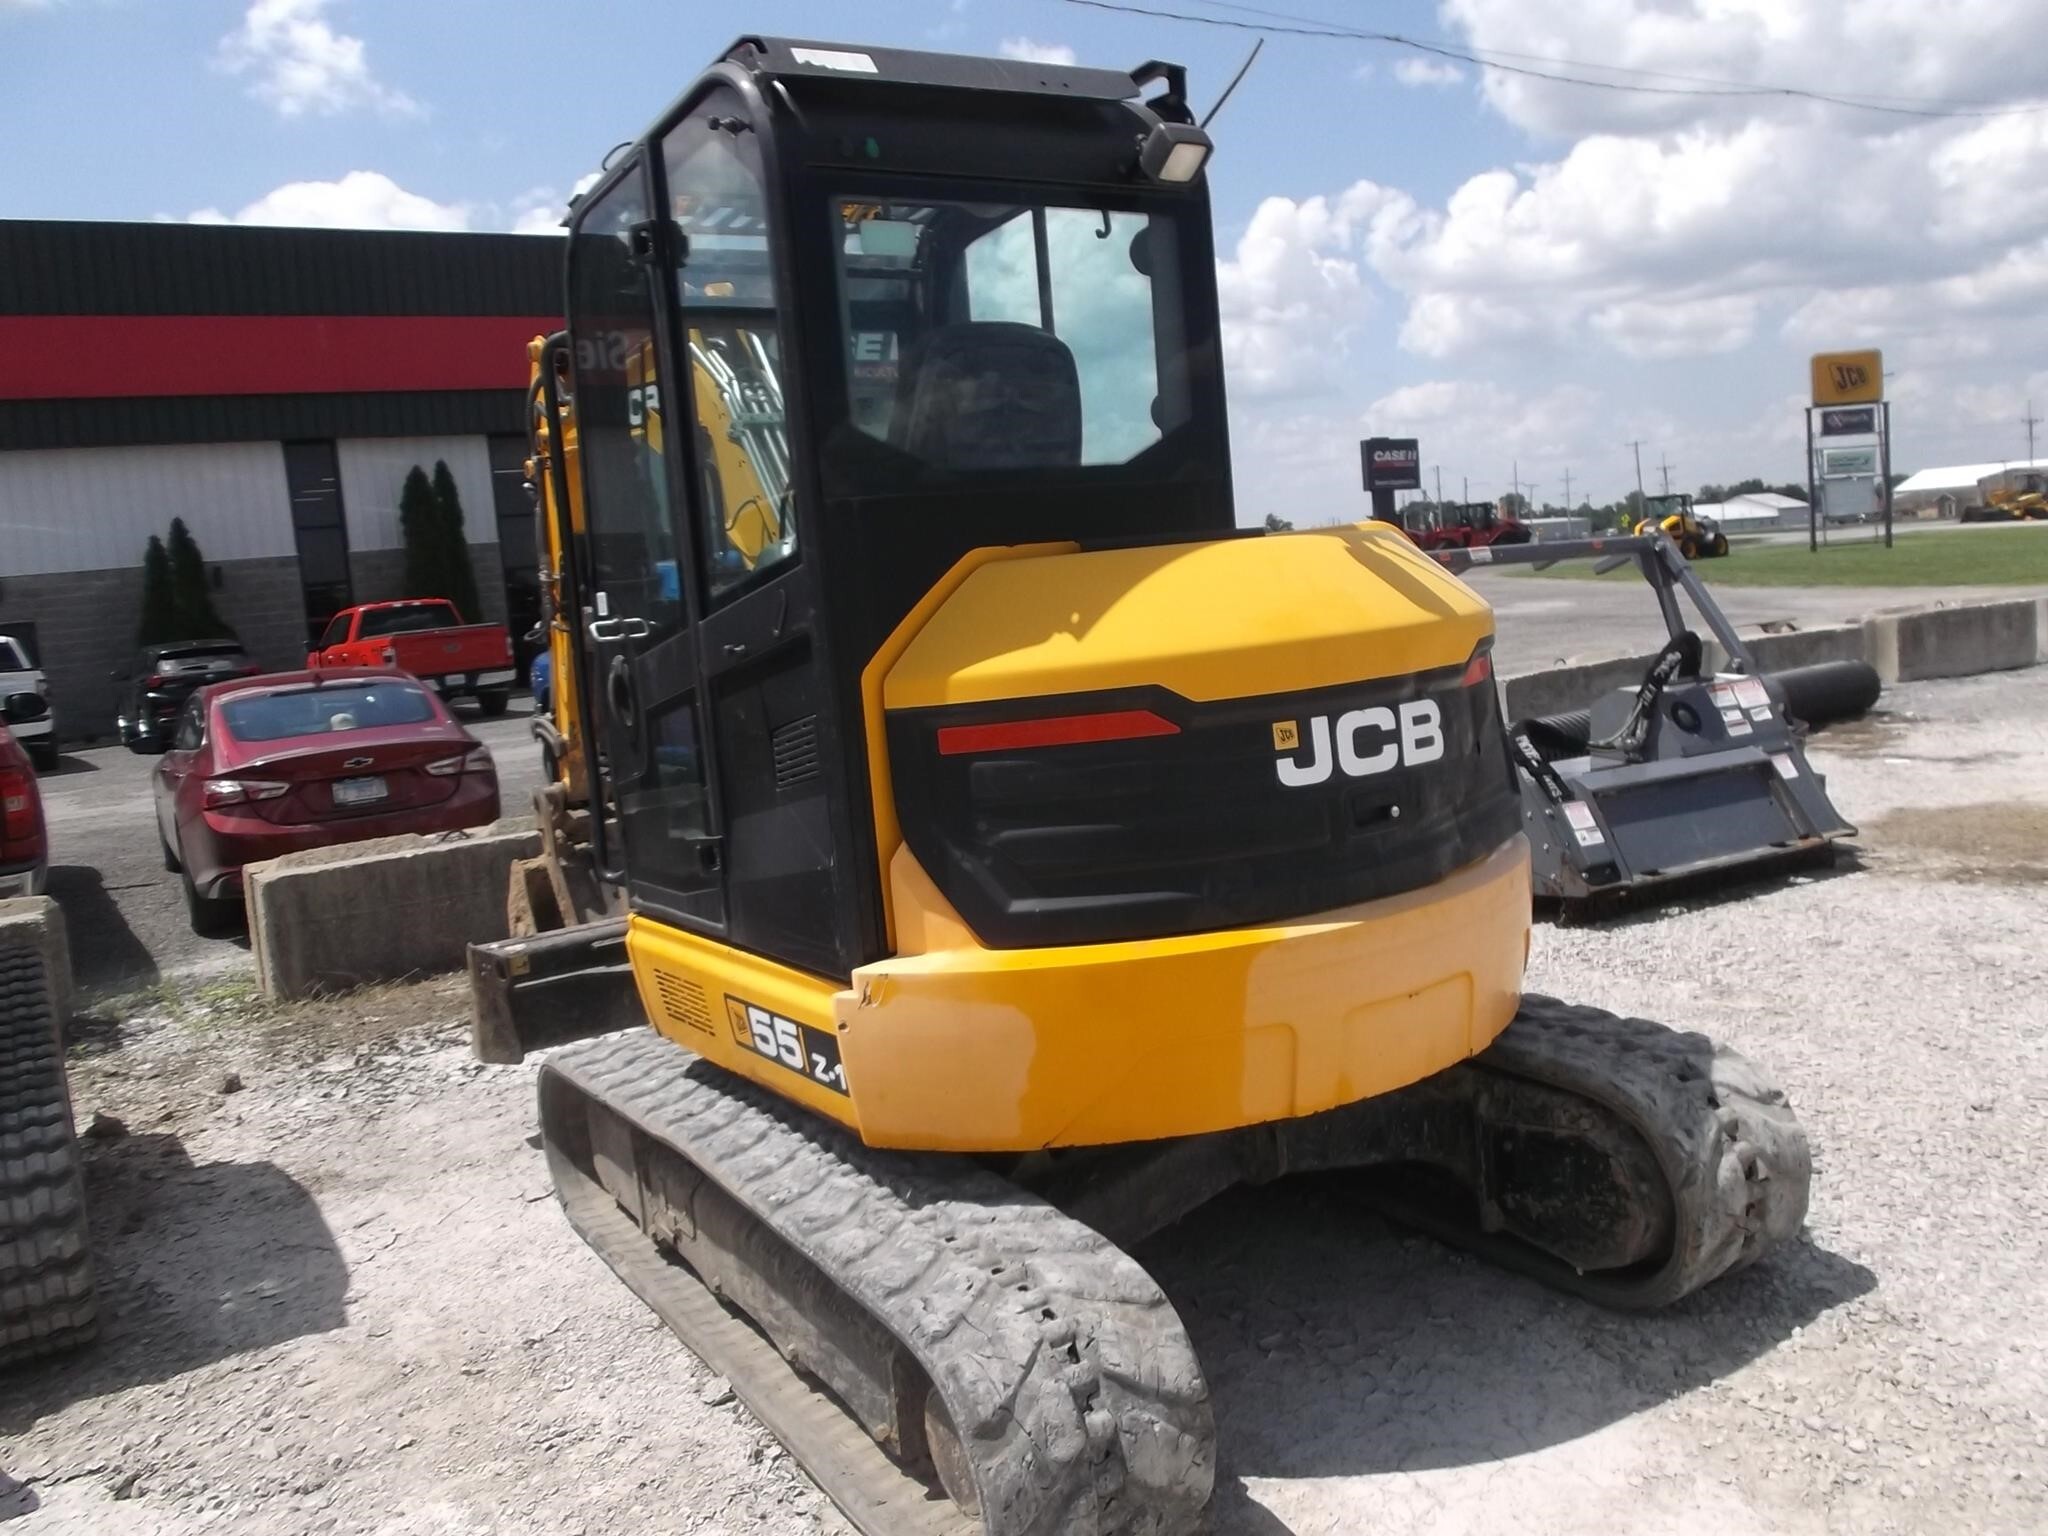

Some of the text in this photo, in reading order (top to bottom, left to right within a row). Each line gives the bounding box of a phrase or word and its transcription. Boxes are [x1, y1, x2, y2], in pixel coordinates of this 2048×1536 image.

[1374, 449, 1406, 461] CASE
[1276, 699, 1444, 787] JCB
[747, 1006, 804, 1069] 55
